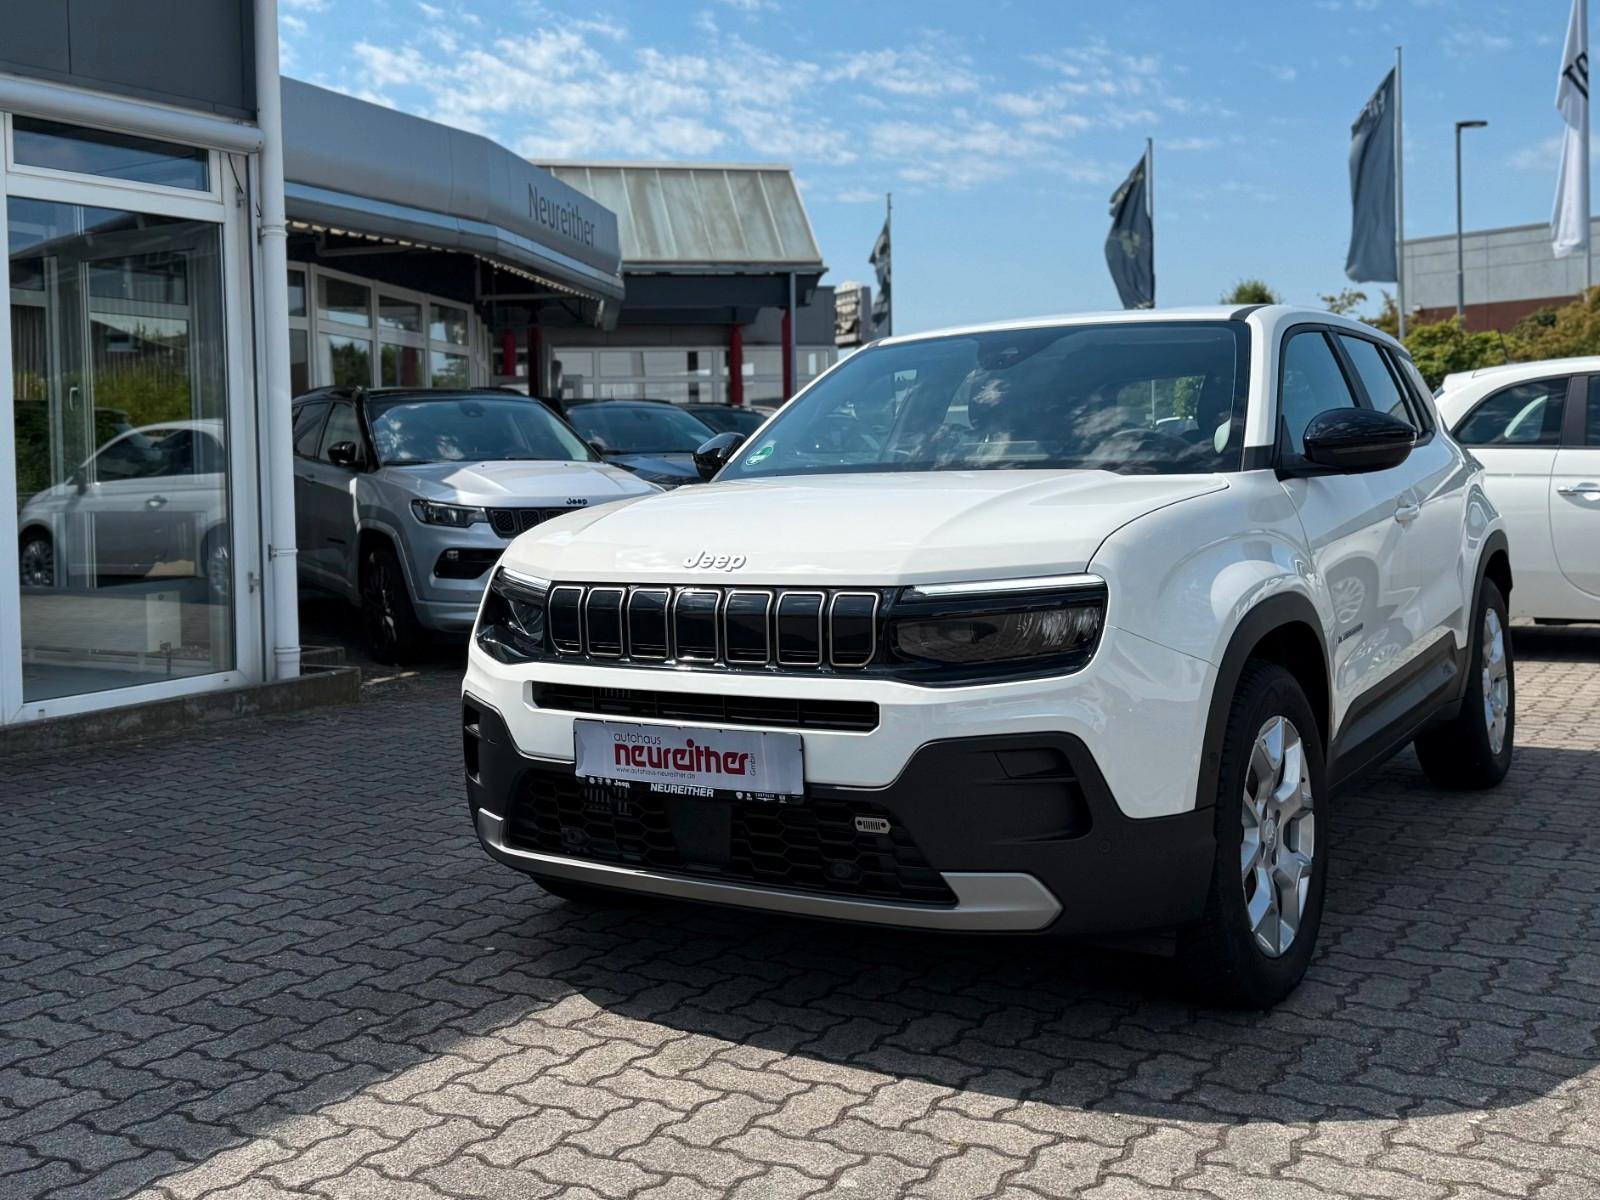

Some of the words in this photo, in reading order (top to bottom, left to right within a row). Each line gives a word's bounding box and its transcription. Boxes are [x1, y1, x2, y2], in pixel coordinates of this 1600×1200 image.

[528, 182, 595, 249] Neureither
[682, 550, 747, 573] Jeep
[613, 733, 662, 745] autohaus
[614, 738, 749, 776] neureither
[650, 783, 715, 798] NEUREITHER
